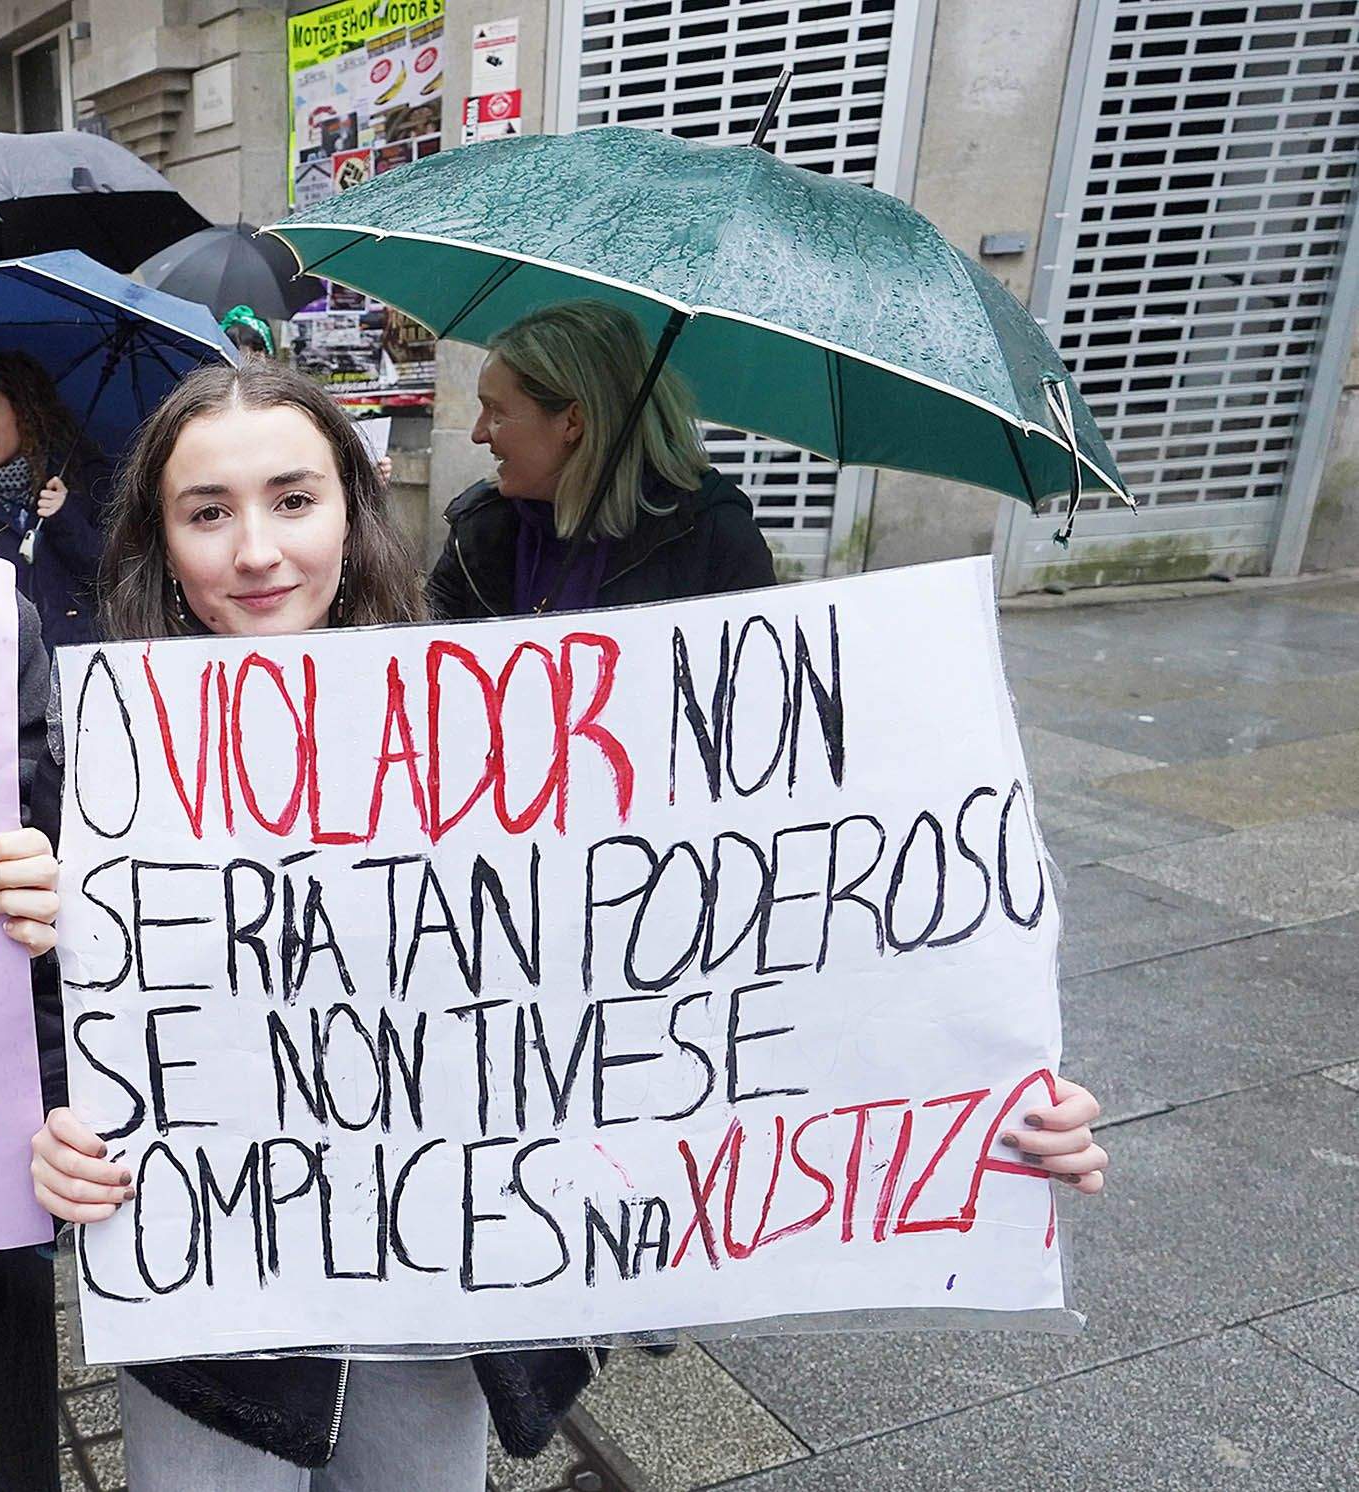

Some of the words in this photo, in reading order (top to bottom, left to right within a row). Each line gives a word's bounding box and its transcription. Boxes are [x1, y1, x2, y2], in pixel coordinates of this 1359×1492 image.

[293, 24, 337, 48] MOTOR
[74, 649, 140, 838] O
[142, 631, 633, 844] VIOLADOR
[666, 604, 845, 803] NON
[351, 841, 540, 998] TAN
[581, 780, 1044, 994] PODEROSO
[73, 1005, 219, 1142] SE
[267, 1001, 426, 1133] NON
[445, 979, 808, 1137] TIVESE
[79, 1136, 569, 1303] COMPLICES
[584, 1197, 669, 1287] NA
[670, 1067, 1058, 1269] XUSTIZA
